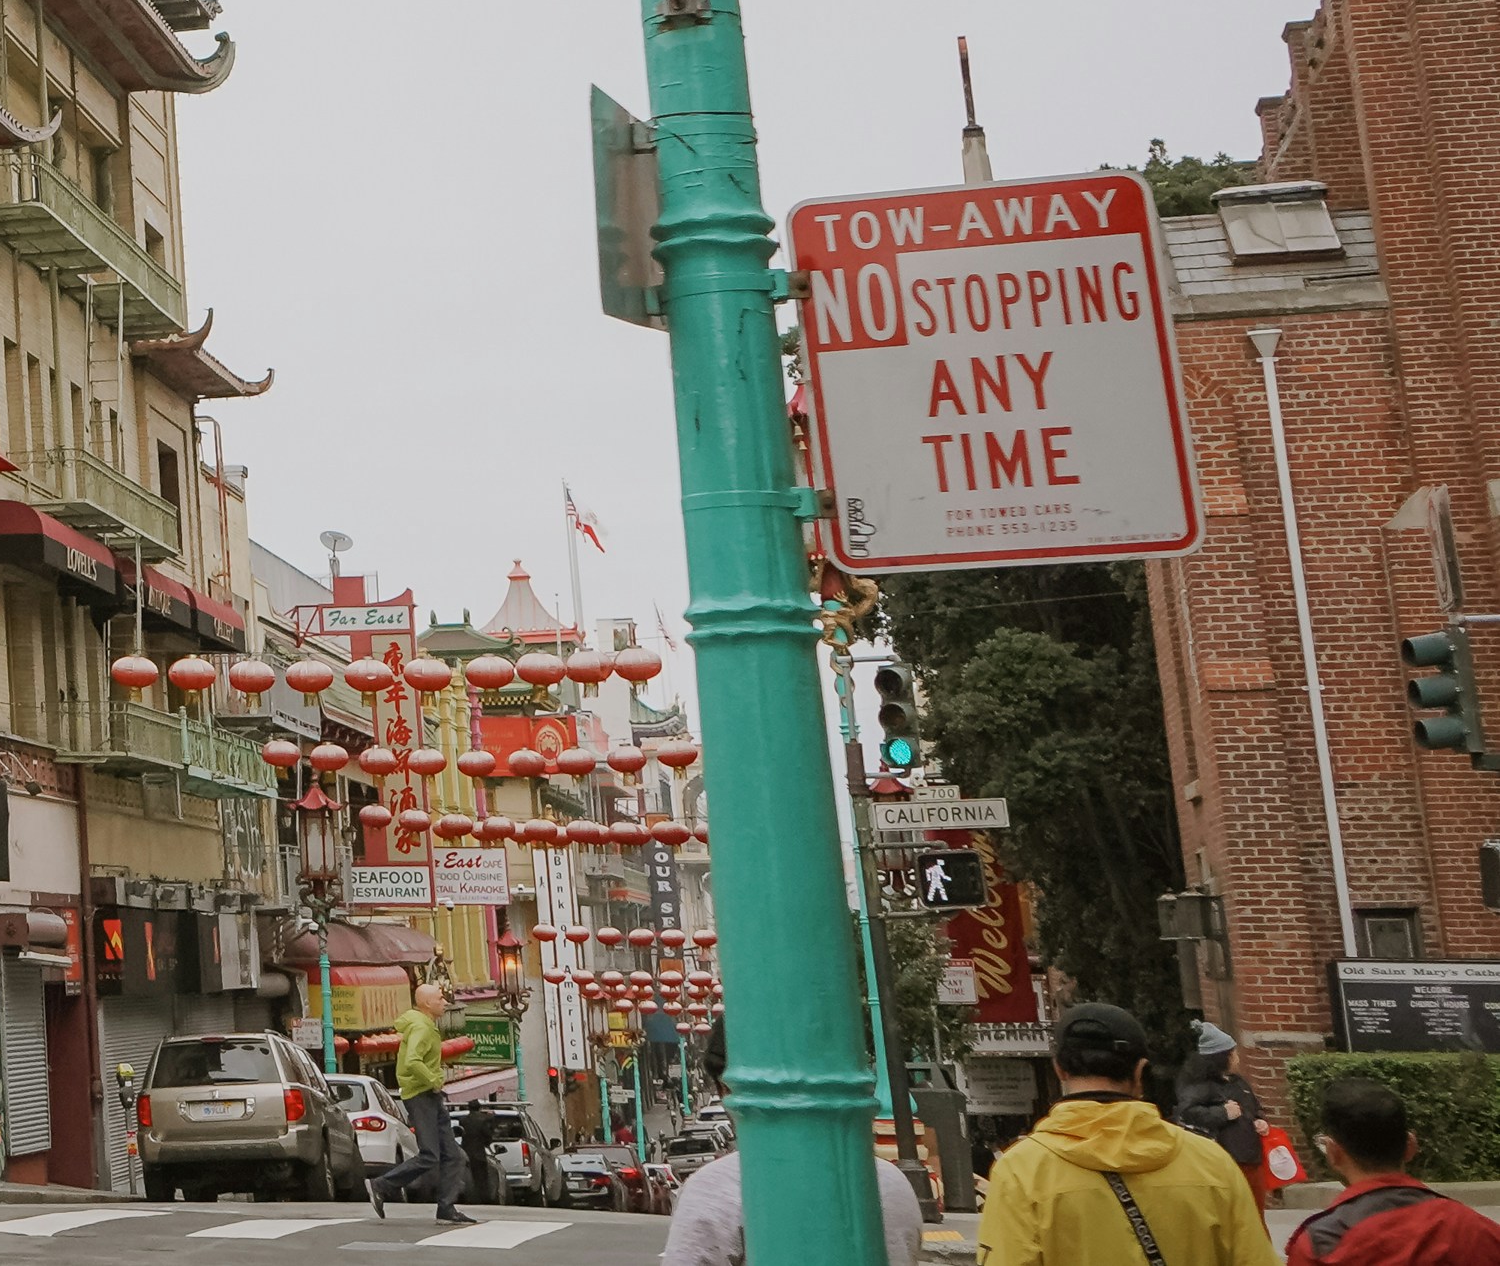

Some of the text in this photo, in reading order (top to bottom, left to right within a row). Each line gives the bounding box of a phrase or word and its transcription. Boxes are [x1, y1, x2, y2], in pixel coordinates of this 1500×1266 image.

[814, 188, 1119, 252] TOW-AWAY
[810, 261, 1141, 345] NO STOPPING
[928, 350, 1054, 418] ANY
[921, 426, 1081, 493] TIME
[946, 502, 1073, 522] FOR TOWED CARS
[945, 519, 1078, 538] PHONE 553-1235
[66, 546, 98, 582] LOVELL'S
[328, 608, 404, 627] Far East
[929, 788, 956, 800] 700
[884, 805, 997, 824] CALIFORNIA
[444, 852, 482, 869] East
[351, 871, 424, 884] SEAFOOD
[353, 887, 427, 898] ESTAURANT
[660, 902, 676, 957] SES
[553, 856, 578, 1062] Bank of America
[1343, 967, 1500, 978] Old Saint Mary's Cathe
[1414, 986, 1453, 994] WELCOME
[1348, 999, 1397, 1008] MASS TIMES
[1410, 1000, 1439, 1008] CHURCH
